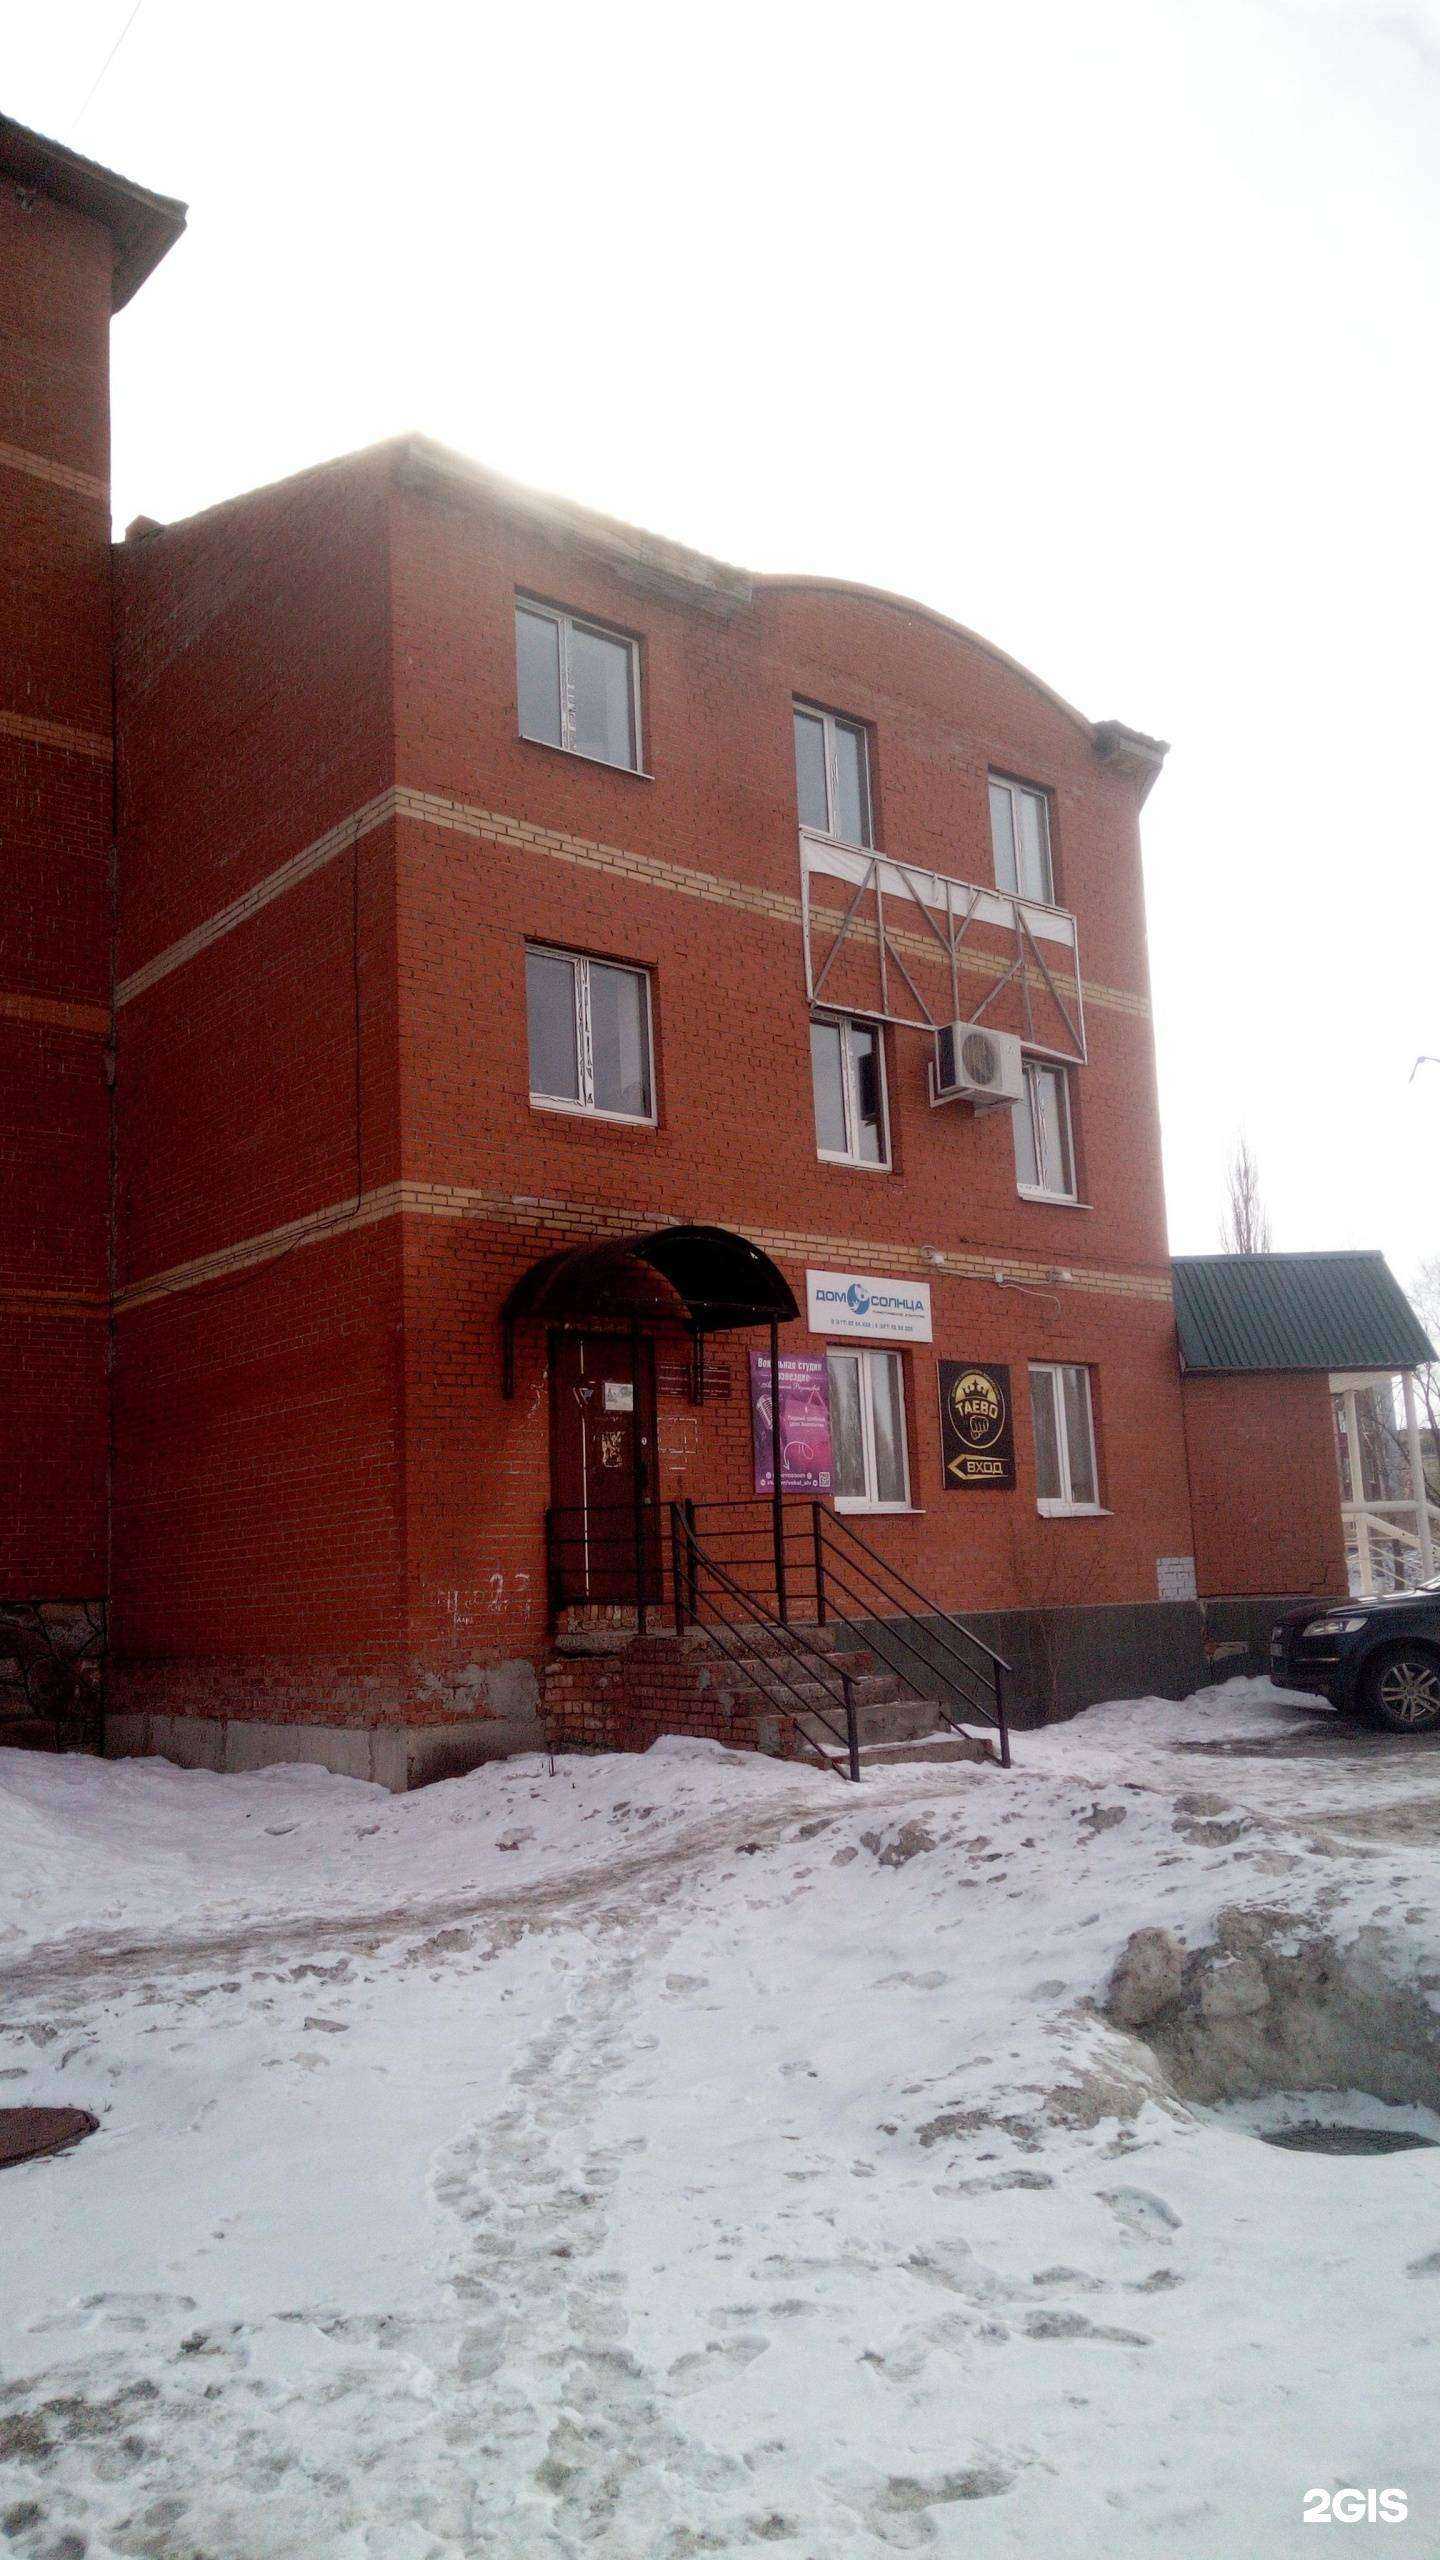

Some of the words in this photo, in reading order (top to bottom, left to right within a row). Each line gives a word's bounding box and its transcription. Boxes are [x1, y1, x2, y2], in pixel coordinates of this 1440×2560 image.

[816, 1290, 847, 1303] ДОМ
[871, 1295, 924, 1312] СОЛНЦА
[966, 1461, 1003, 1475] ВХОД
